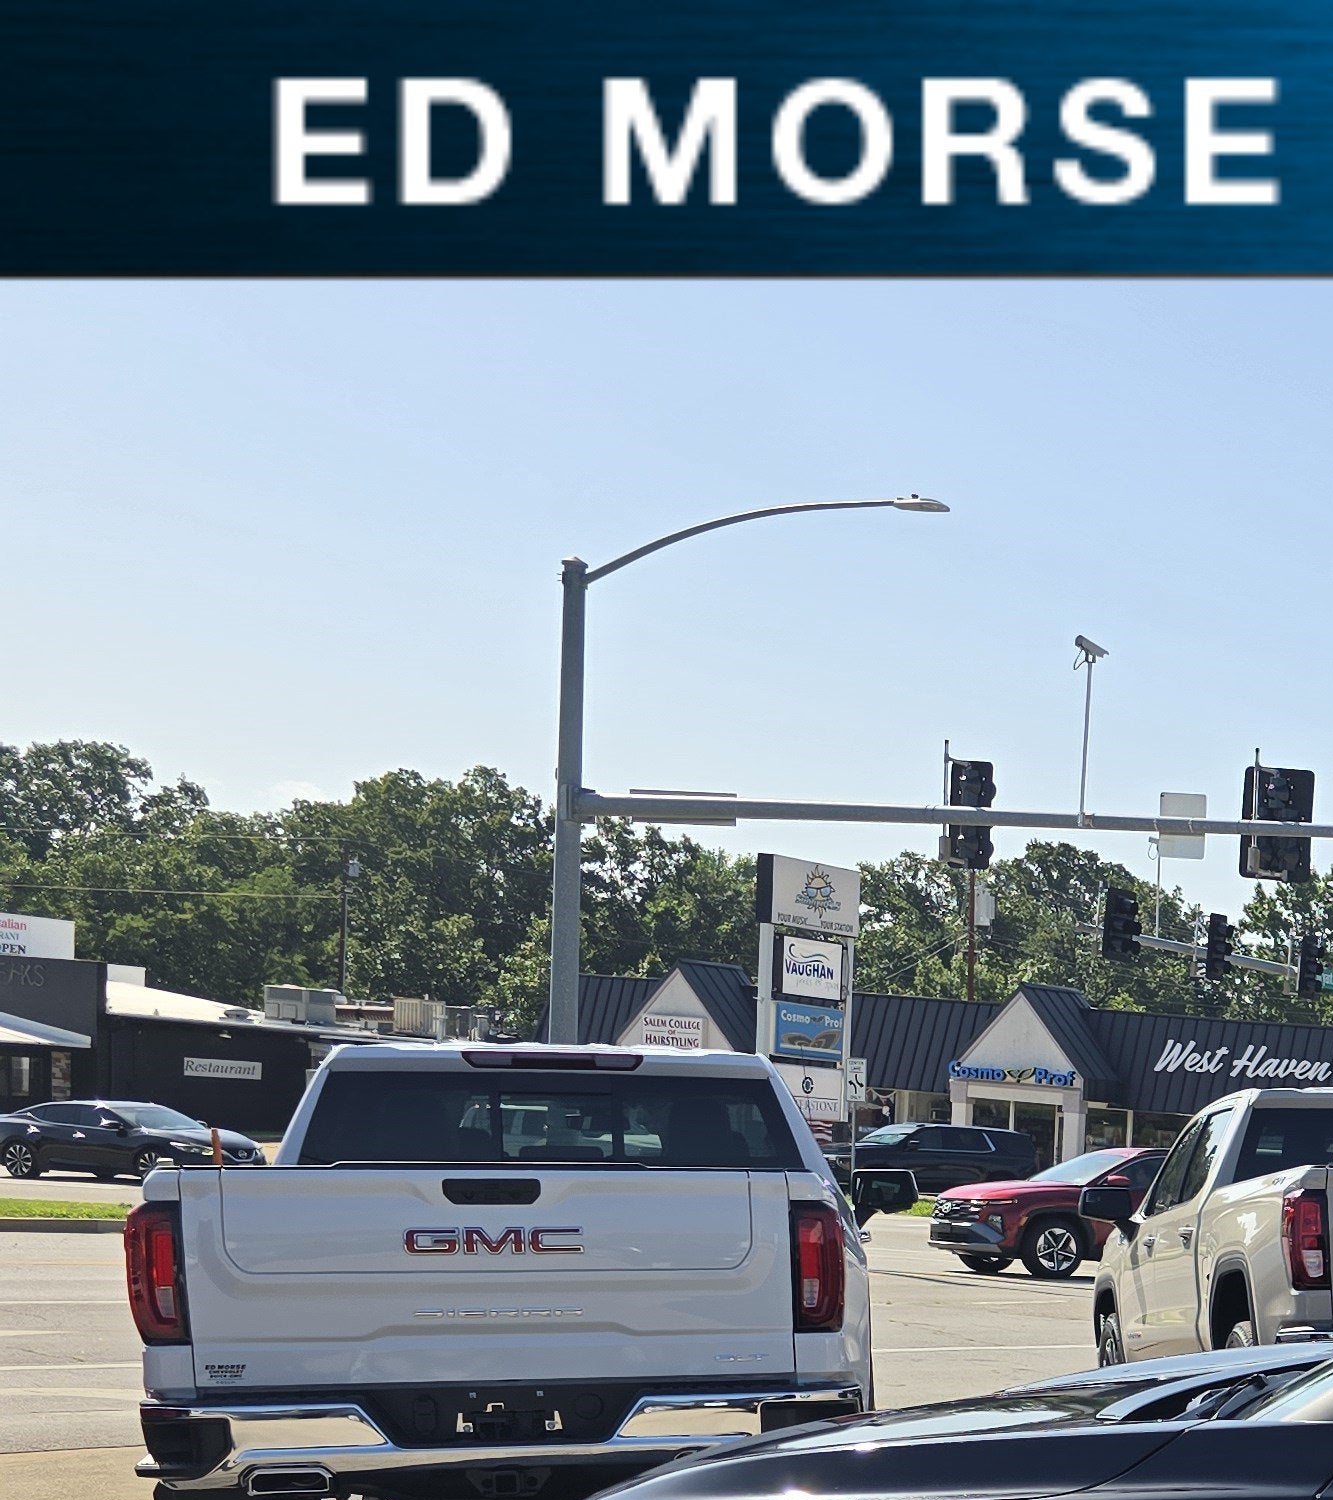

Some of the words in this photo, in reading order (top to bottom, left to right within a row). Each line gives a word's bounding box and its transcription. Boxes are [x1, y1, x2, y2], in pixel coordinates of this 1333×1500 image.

[0, 917, 27, 931] alian
[785, 959, 834, 980] VAUGHAN
[644, 1017, 667, 1028] SALEM
[668, 1018, 701, 1031] COLLEGE
[780, 1009, 811, 1024] Cosmo
[645, 1033, 700, 1048] HAIRSTYLING
[185, 1060, 256, 1075] Restaurant
[1153, 1039, 1230, 1074] West
[1229, 1044, 1333, 1082] Haven
[948, 1060, 1007, 1082] Cosmo
[1033, 1067, 1077, 1087] Prof
[403, 1226, 585, 1255] GMC
[413, 1307, 584, 1319] SIERRA
